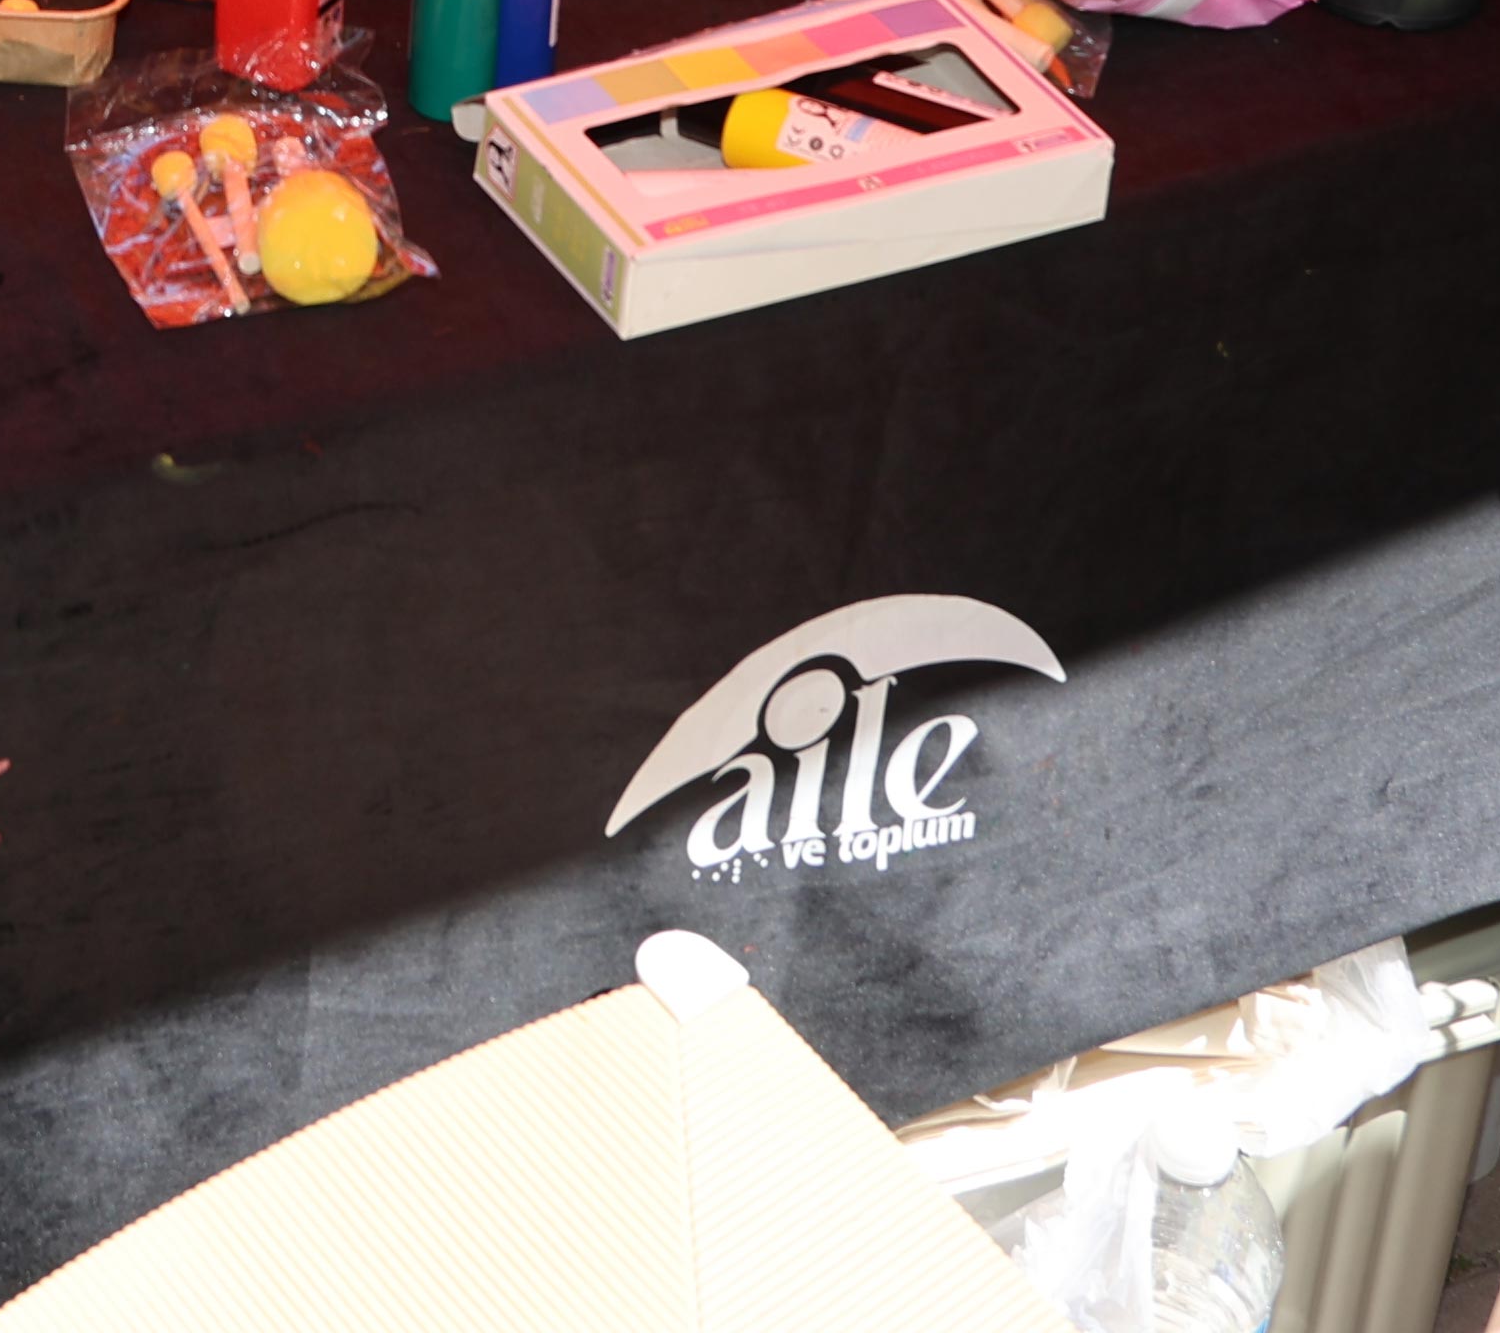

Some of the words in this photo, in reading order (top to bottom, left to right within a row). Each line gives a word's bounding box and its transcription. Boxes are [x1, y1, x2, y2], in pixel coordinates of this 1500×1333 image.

[686, 667, 979, 869] aile
[780, 835, 827, 870] ve
[837, 811, 977, 871] toplum
